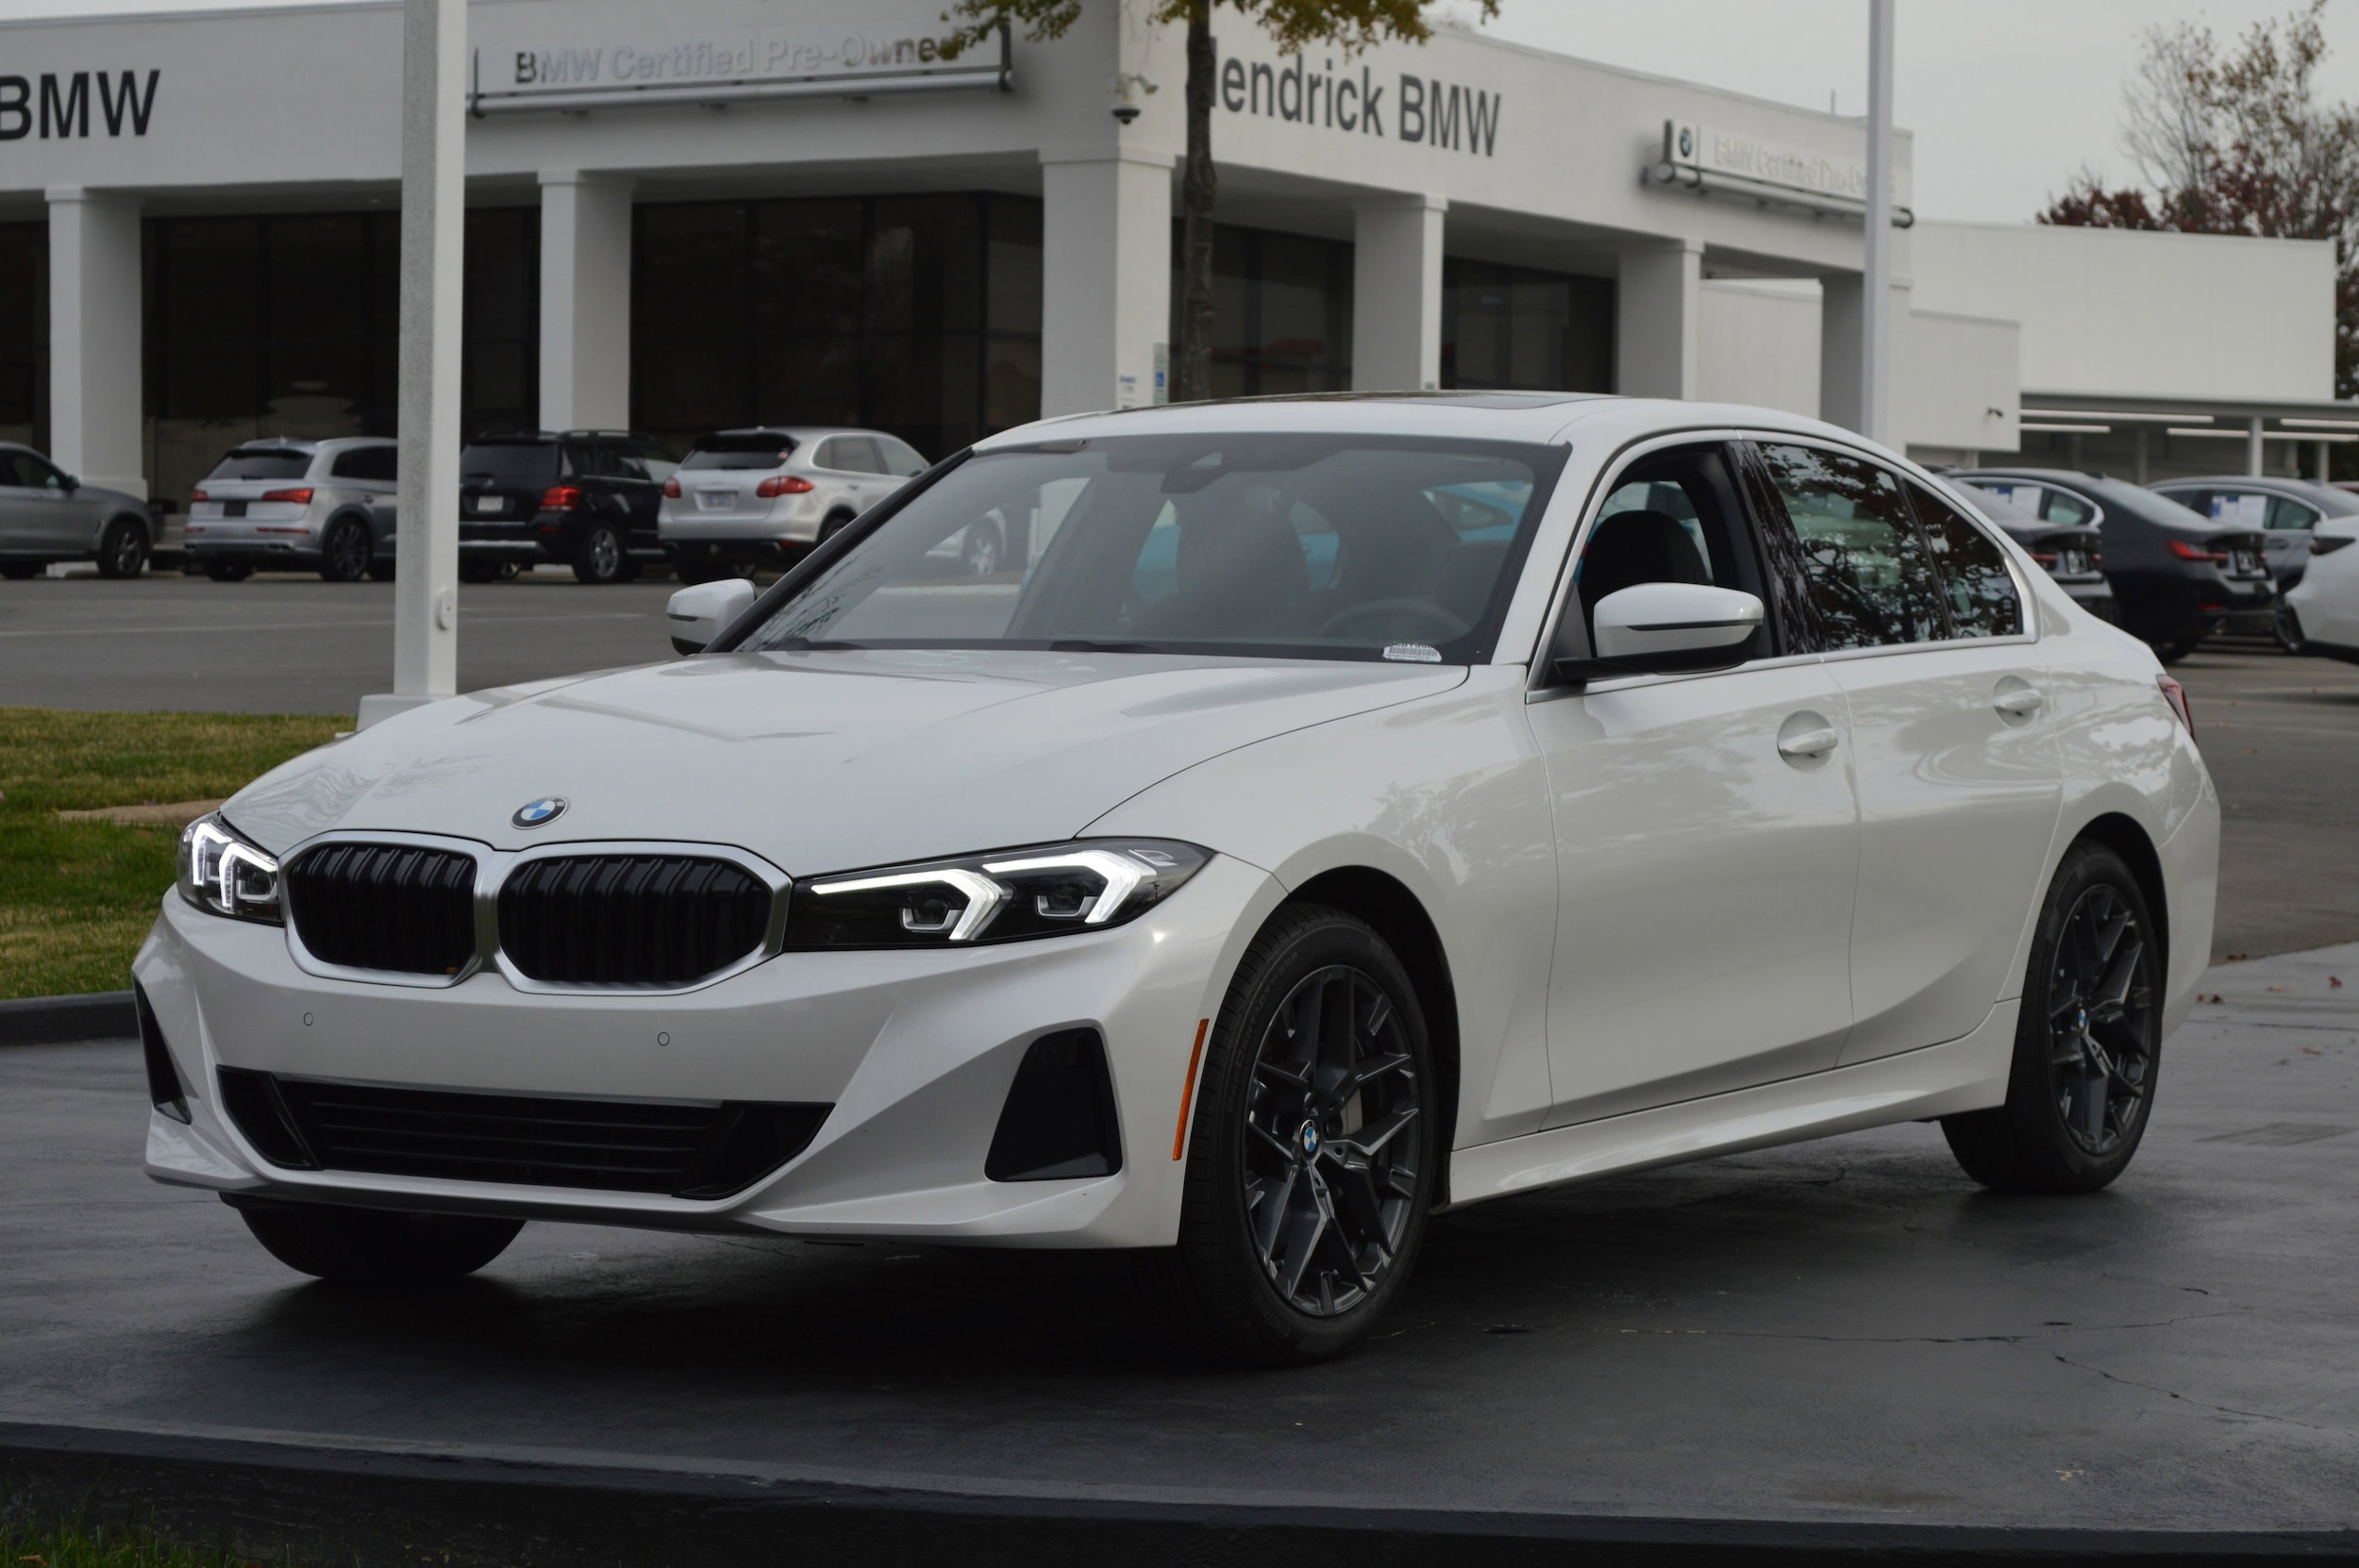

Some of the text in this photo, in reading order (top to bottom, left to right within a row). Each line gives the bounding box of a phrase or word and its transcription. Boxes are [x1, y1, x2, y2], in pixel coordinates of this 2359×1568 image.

[515, 31, 961, 84] BMW Certified Pre-Owne
[0, 69, 160, 141] BMW
[1209, 37, 1501, 158] endrick BMW
